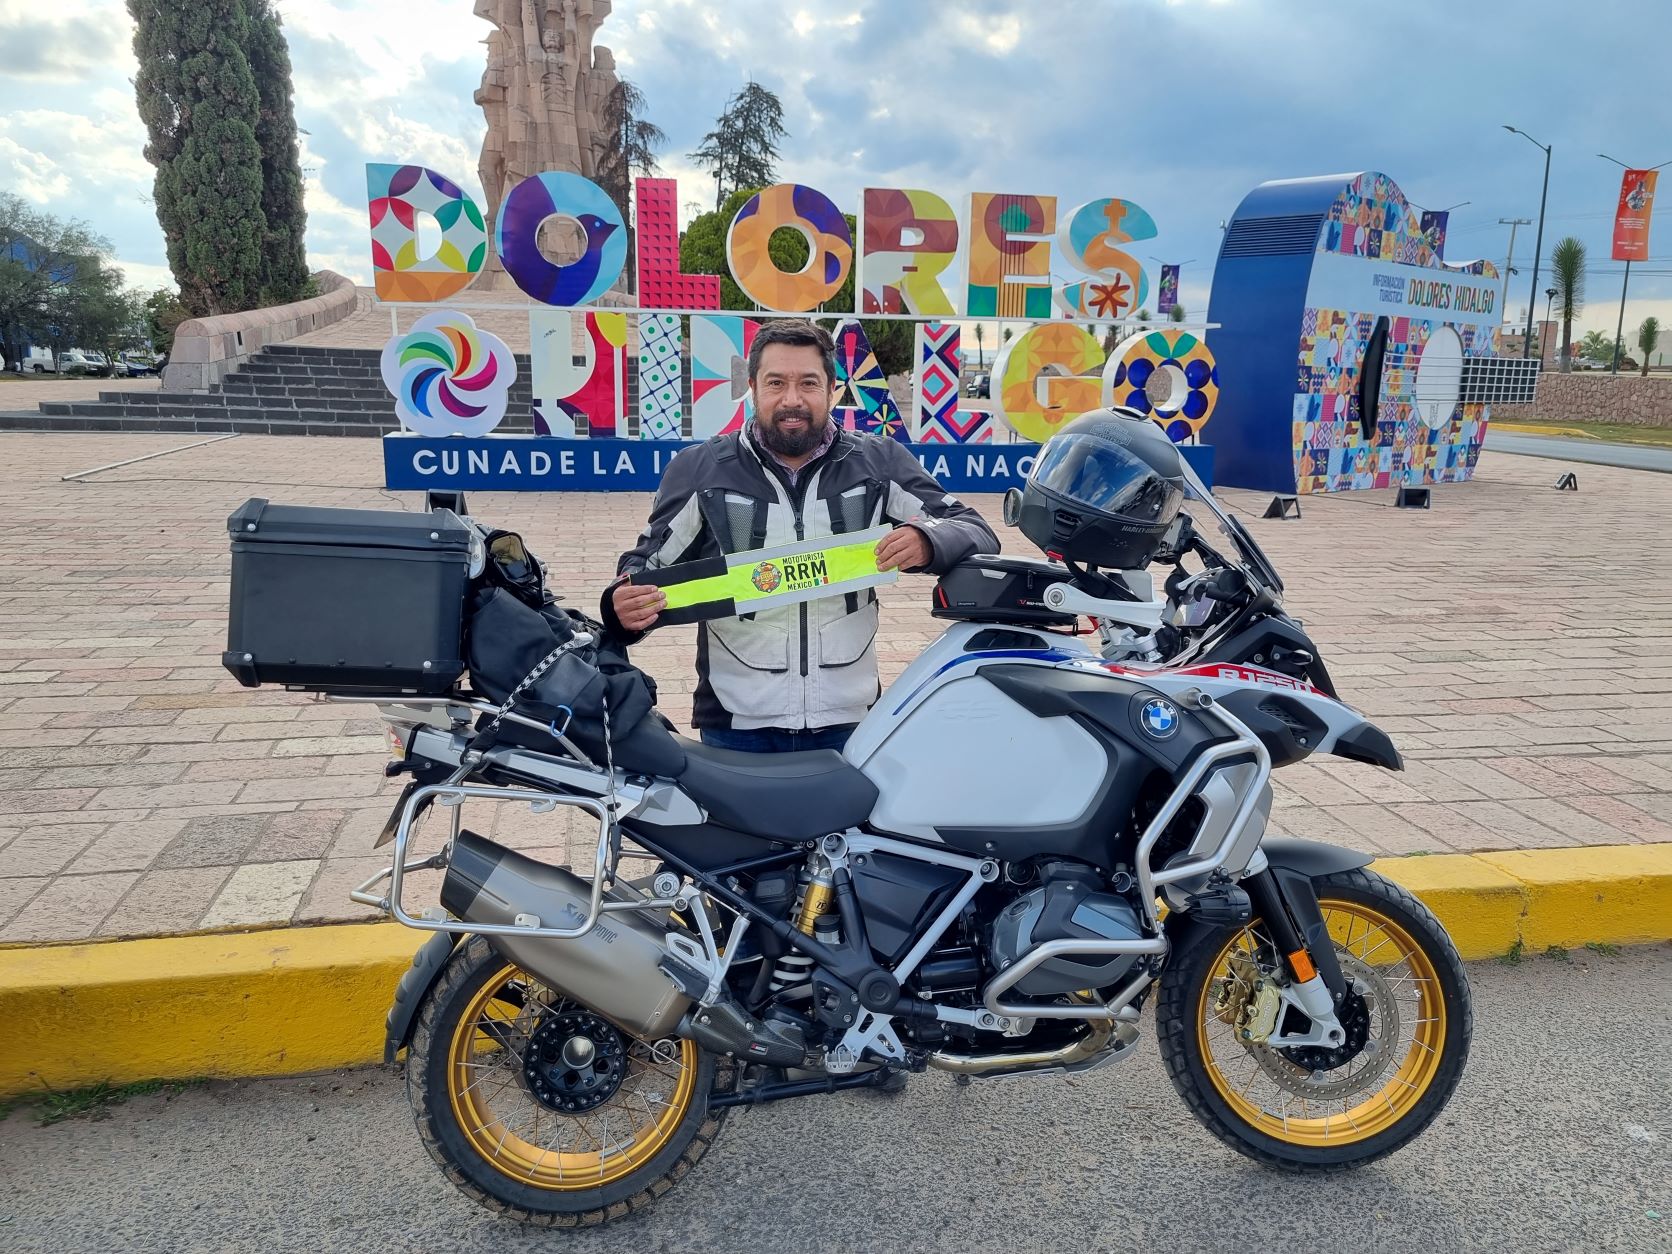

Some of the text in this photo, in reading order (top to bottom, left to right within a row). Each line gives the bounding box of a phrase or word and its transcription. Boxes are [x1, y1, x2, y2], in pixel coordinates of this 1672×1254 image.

[366, 163, 1158, 318] DOLORES
[1407, 278, 1495, 314] DOLORES HIDALGO
[593, 450, 636, 475] LA
[782, 551, 825, 565] MOTOTURISTA
[783, 559, 828, 582] RRM
[1145, 701, 1175, 714] BMW
